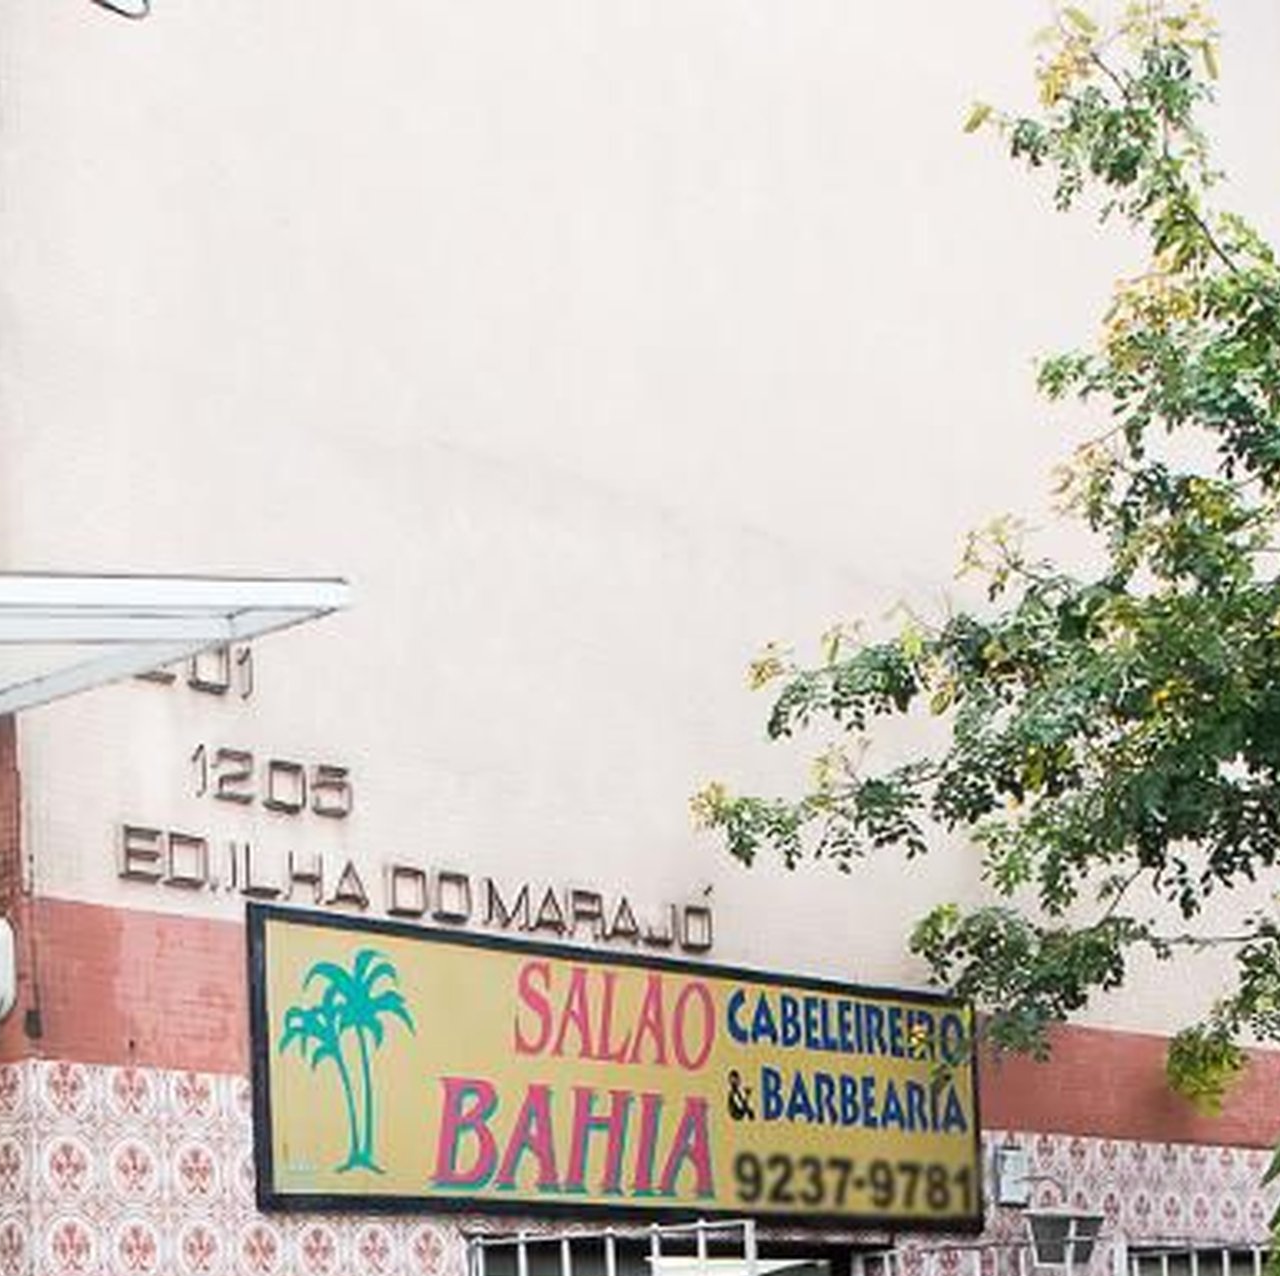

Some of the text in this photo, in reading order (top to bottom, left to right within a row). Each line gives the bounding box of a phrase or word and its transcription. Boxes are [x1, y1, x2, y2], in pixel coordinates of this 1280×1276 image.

[133, 642, 253, 699] 01
[191, 743, 354, 817] 1205
[384, 864, 471, 924] DO
[483, 879, 714, 952] MARAJÓ
[514, 961, 716, 1072] SALAO
[727, 988, 965, 1066] CABELEIREIRO
[429, 1076, 716, 1198] BAHIA
[727, 1065, 968, 1134] & BARBEARIA
[734, 1149, 973, 1211] 9237-9781
